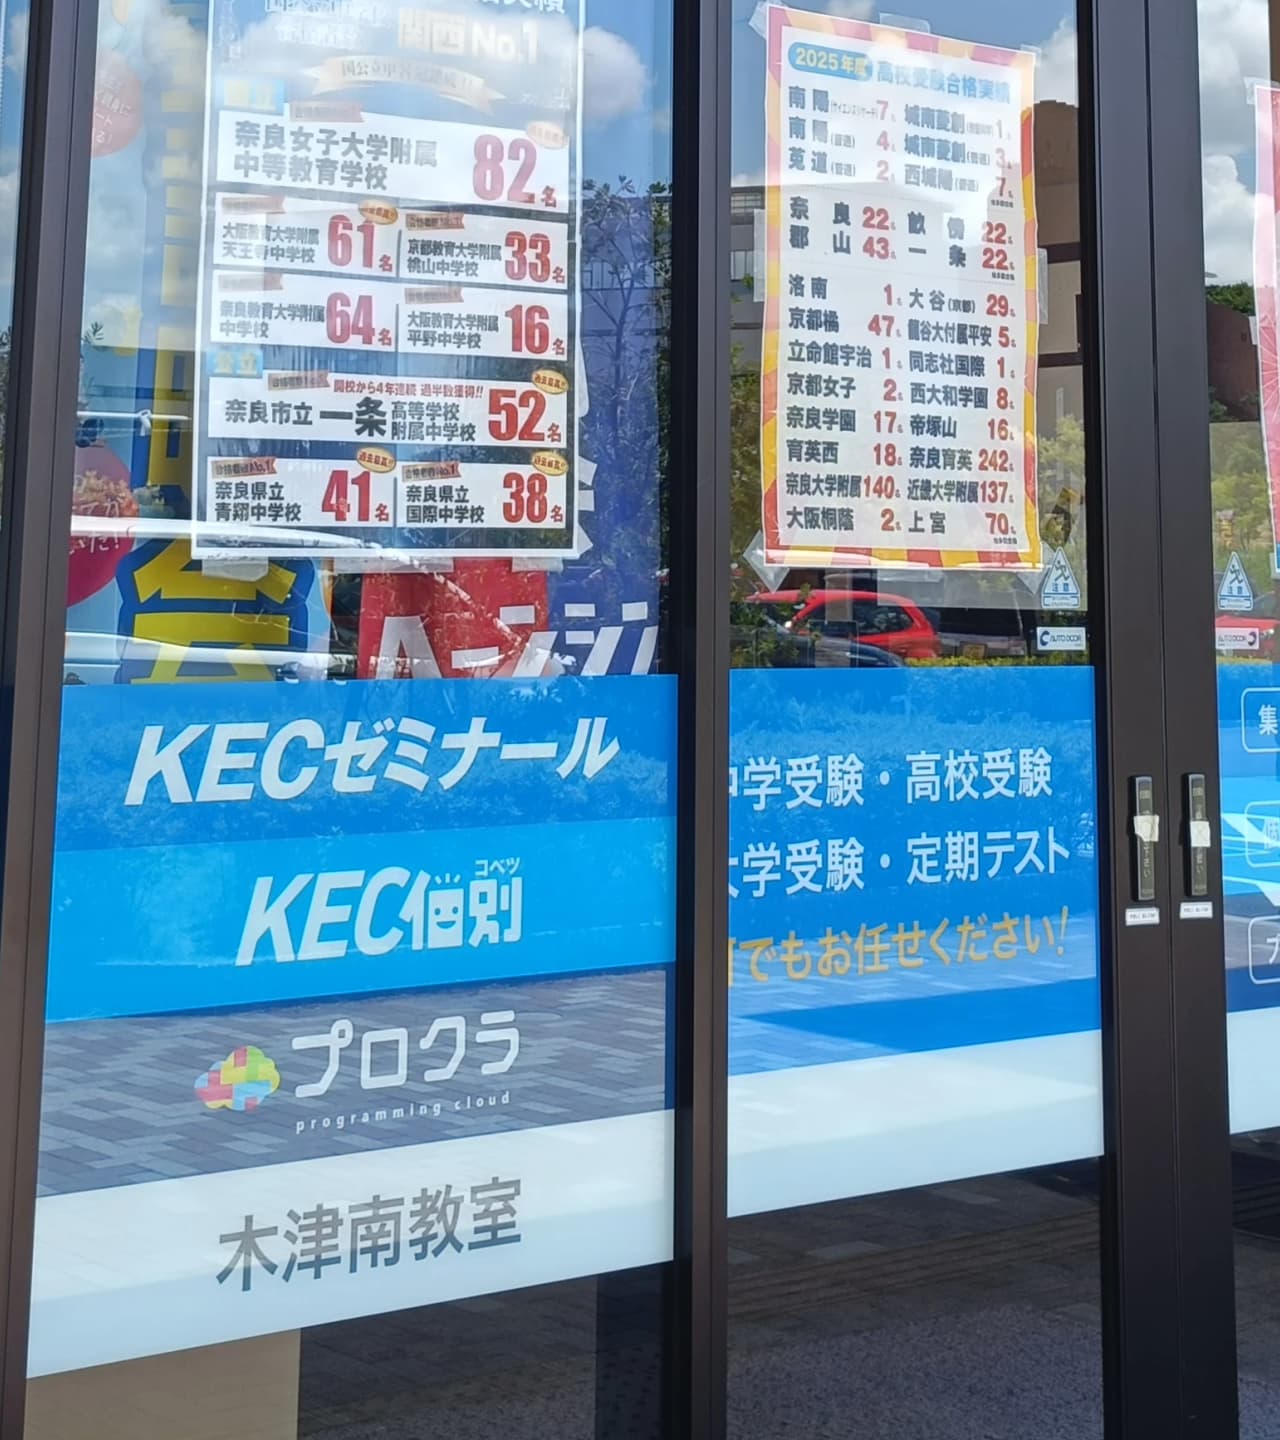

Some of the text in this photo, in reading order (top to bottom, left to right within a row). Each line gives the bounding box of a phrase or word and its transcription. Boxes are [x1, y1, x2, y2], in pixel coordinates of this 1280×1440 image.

[234, 120, 438, 168] 奈良女子大学附属
[233, 153, 387, 190] 中等教育学校
[408, 238, 502, 261] 京都教育大学附属
[220, 321, 482, 350] 中学校 平野中学校
[408, 310, 499, 333] 大阪教育大学附属
[787, 340, 986, 378] 立命館宇治 同志社国際
[787, 372, 988, 410] 京都女子 西大和学園
[225, 399, 313, 426] 奈良市立
[320, 397, 387, 437] 一条
[391, 401, 460, 421] 高等学校
[391, 421, 476, 442] 附属中学校
[786, 405, 957, 438] 奈良学園 帝塚山
[786, 439, 839, 465] 育英西
[909, 446, 973, 472] 奈良育英
[215, 481, 285, 501] 奈良県立
[406, 485, 470, 503] 奈良県立
[786, 473, 862, 498] 奈良大学附属
[215, 502, 485, 525] 青翔中学校 国際中学校
[908, 511, 946, 534] 上宮
[123, 716, 620, 806] KECゼミナール
[473, 857, 521, 877] コベツ
[728, 826, 1070, 899] 学受験・定期テスト
[234, 866, 522, 966] KEC個別
[728, 905, 1069, 987] でもお任せください!
[295, 1090, 511, 1135] programming cloud
[216, 1176, 522, 1292] 木津南教室
